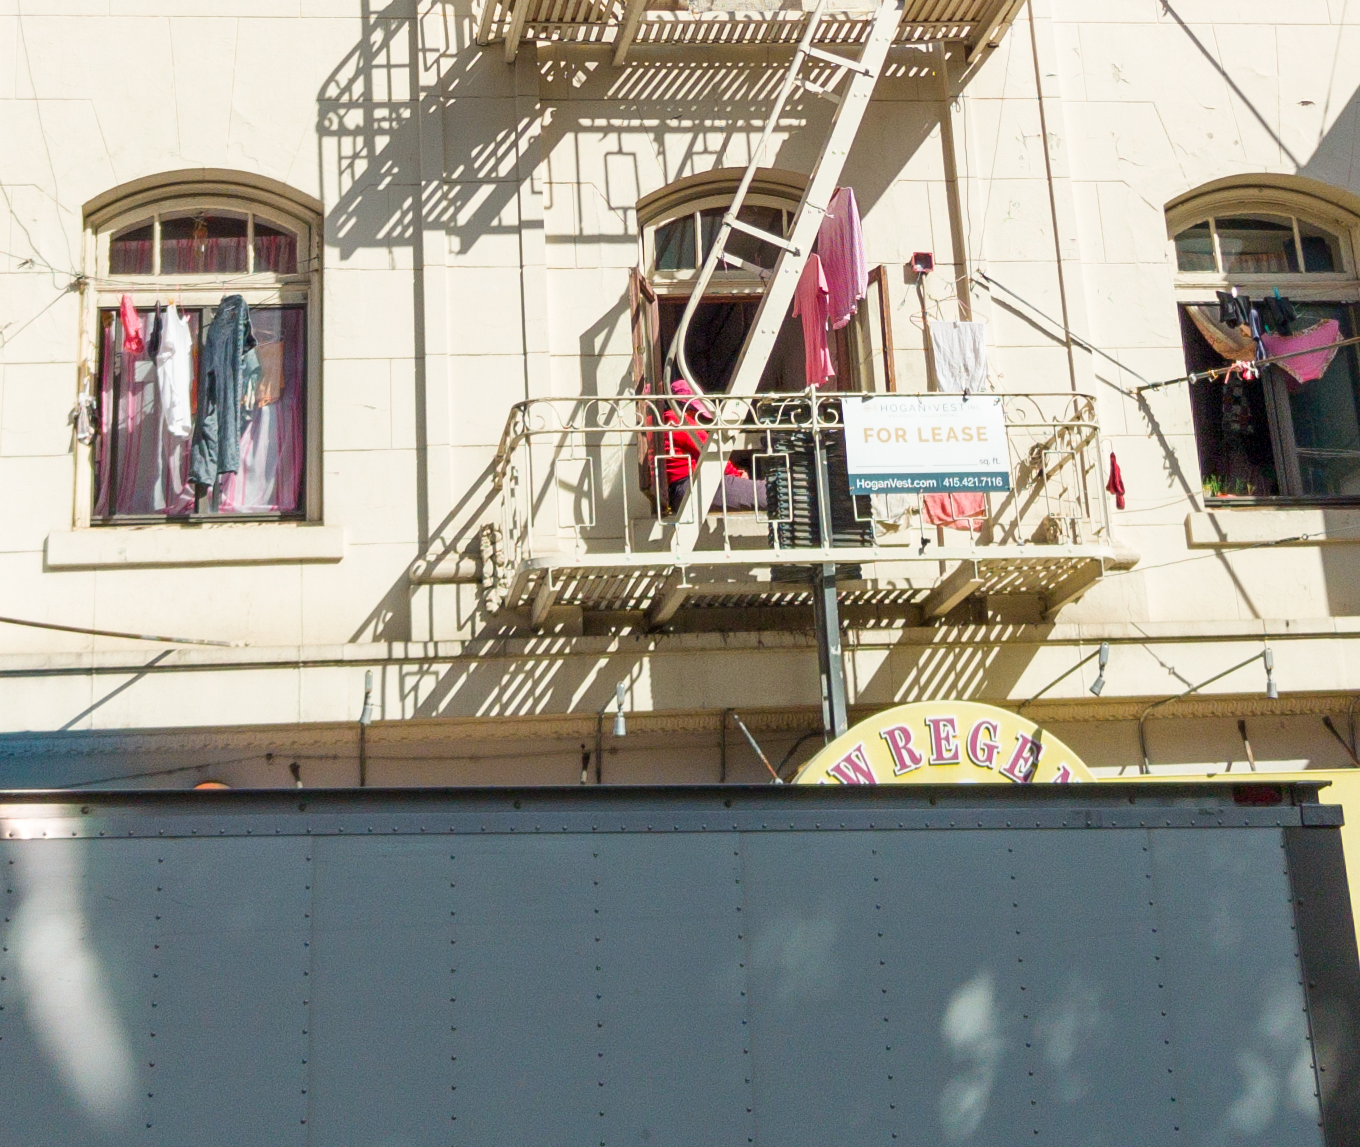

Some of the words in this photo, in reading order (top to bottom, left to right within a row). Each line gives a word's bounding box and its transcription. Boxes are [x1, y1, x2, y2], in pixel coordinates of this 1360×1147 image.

[863, 427, 908, 443] FOR
[917, 426, 988, 443] LEASE
[856, 478, 937, 490] HoganVest.com
[942, 476, 1003, 488] 415.421.7116
[880, 714, 1080, 784] REGE
